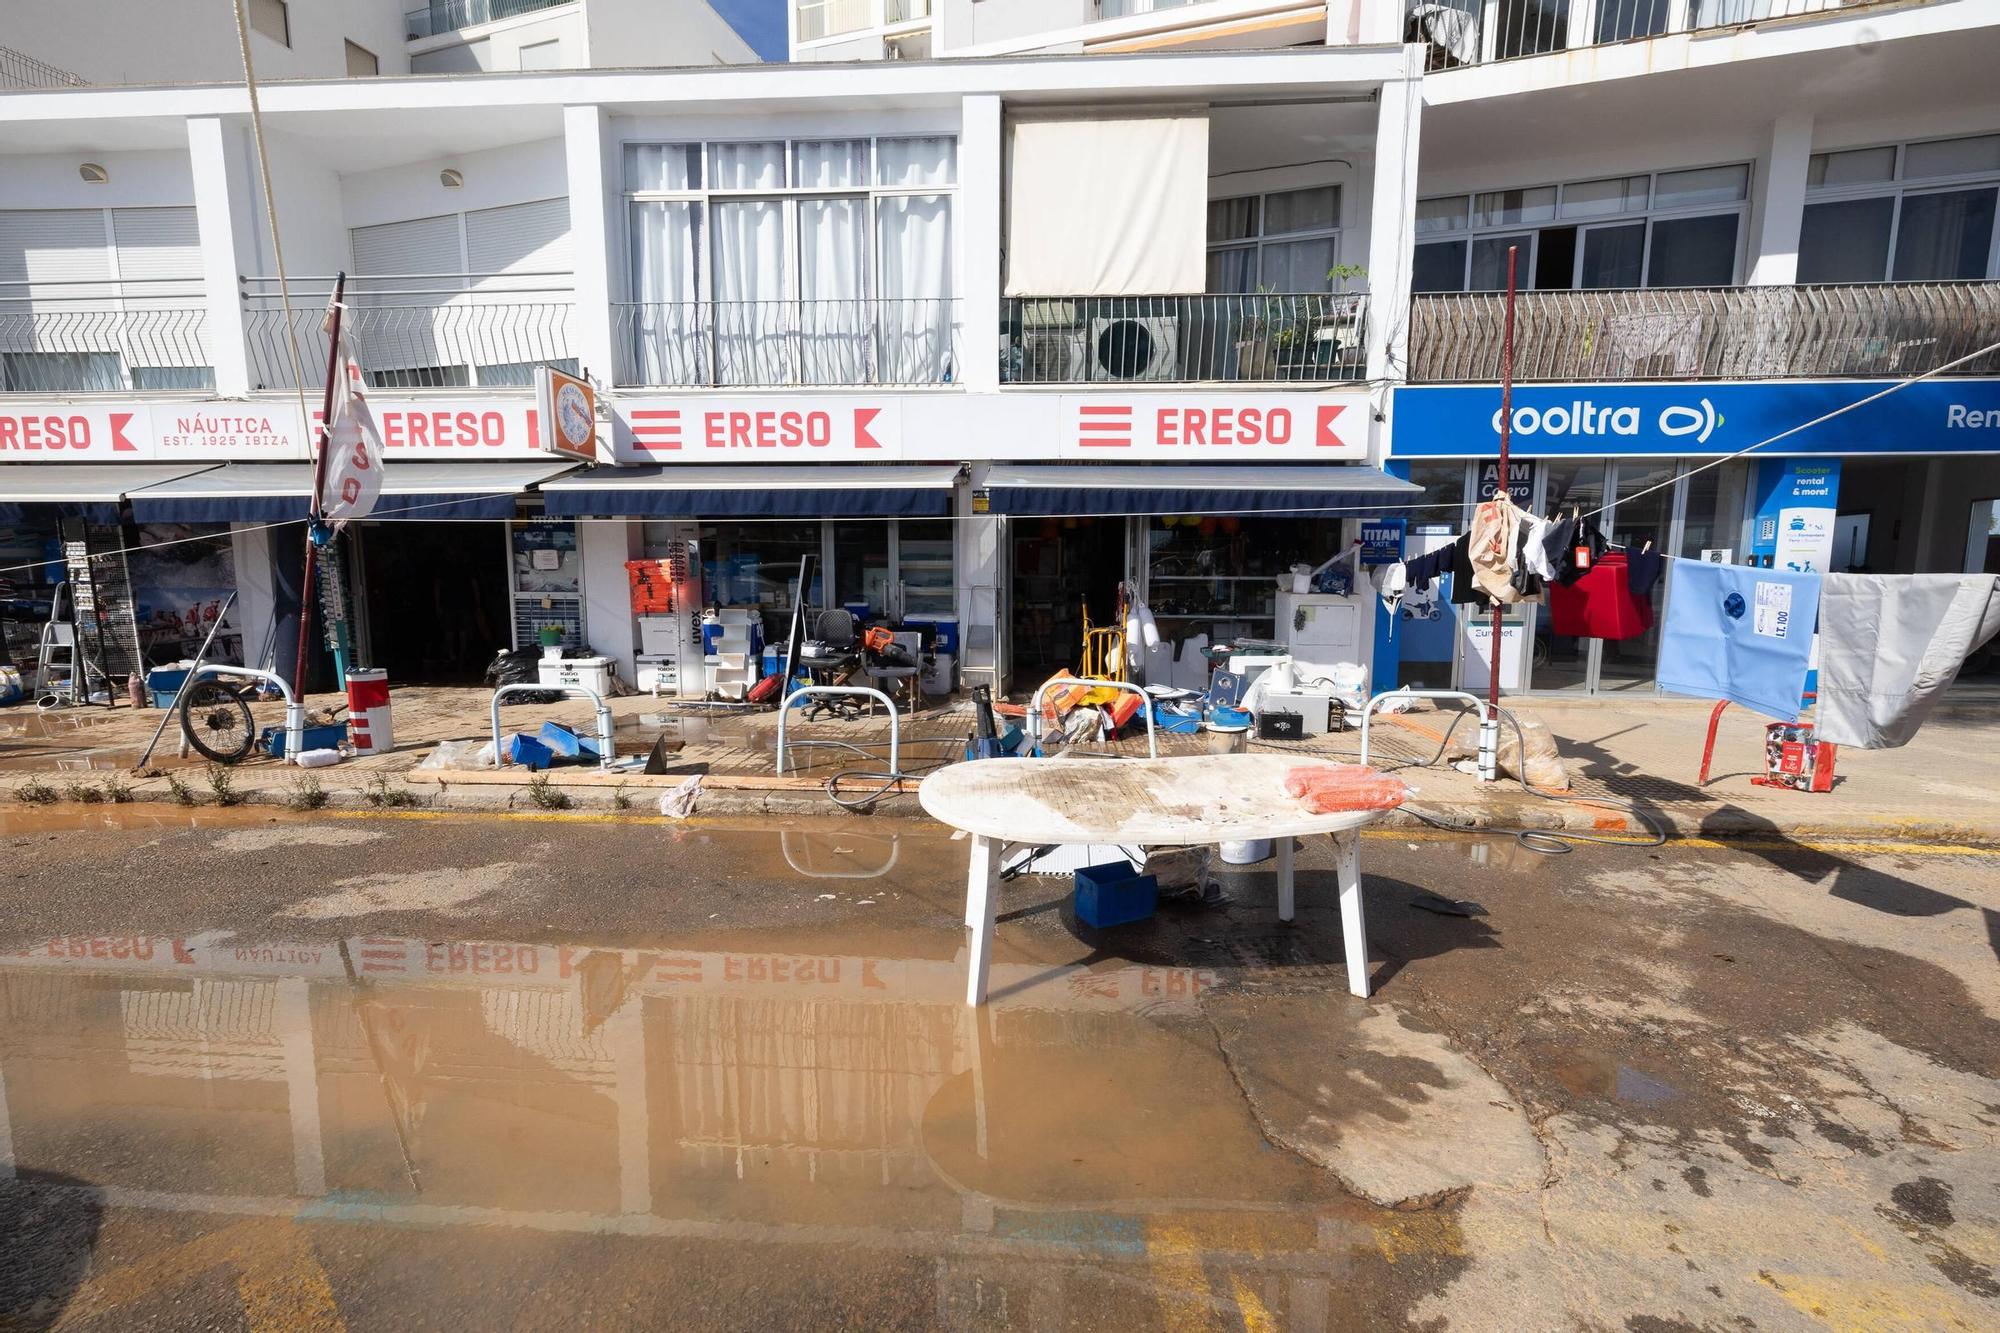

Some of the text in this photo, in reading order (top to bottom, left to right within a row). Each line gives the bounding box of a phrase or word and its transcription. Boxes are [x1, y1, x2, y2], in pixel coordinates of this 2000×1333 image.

[177, 412, 273, 434] NÁUTICA
[1492, 401, 1640, 435] cooltra
[1947, 404, 2000, 428] Ren
[383, 411, 505, 447] ERESO
[704, 411, 831, 448] ERESO
[1156, 407, 1292, 445] ERESO
[163, 435, 289, 446] EST. 1925 IBIZA
[1483, 464, 1530, 480] AM
[1795, 466, 1831, 475] Scooter
[1796, 477, 1825, 485] rental
[1792, 488, 1829, 496] & more!
[1363, 529, 1400, 541] TITAN
[691, 610, 702, 645] uvex
[1776, 611, 1789, 625] 100
